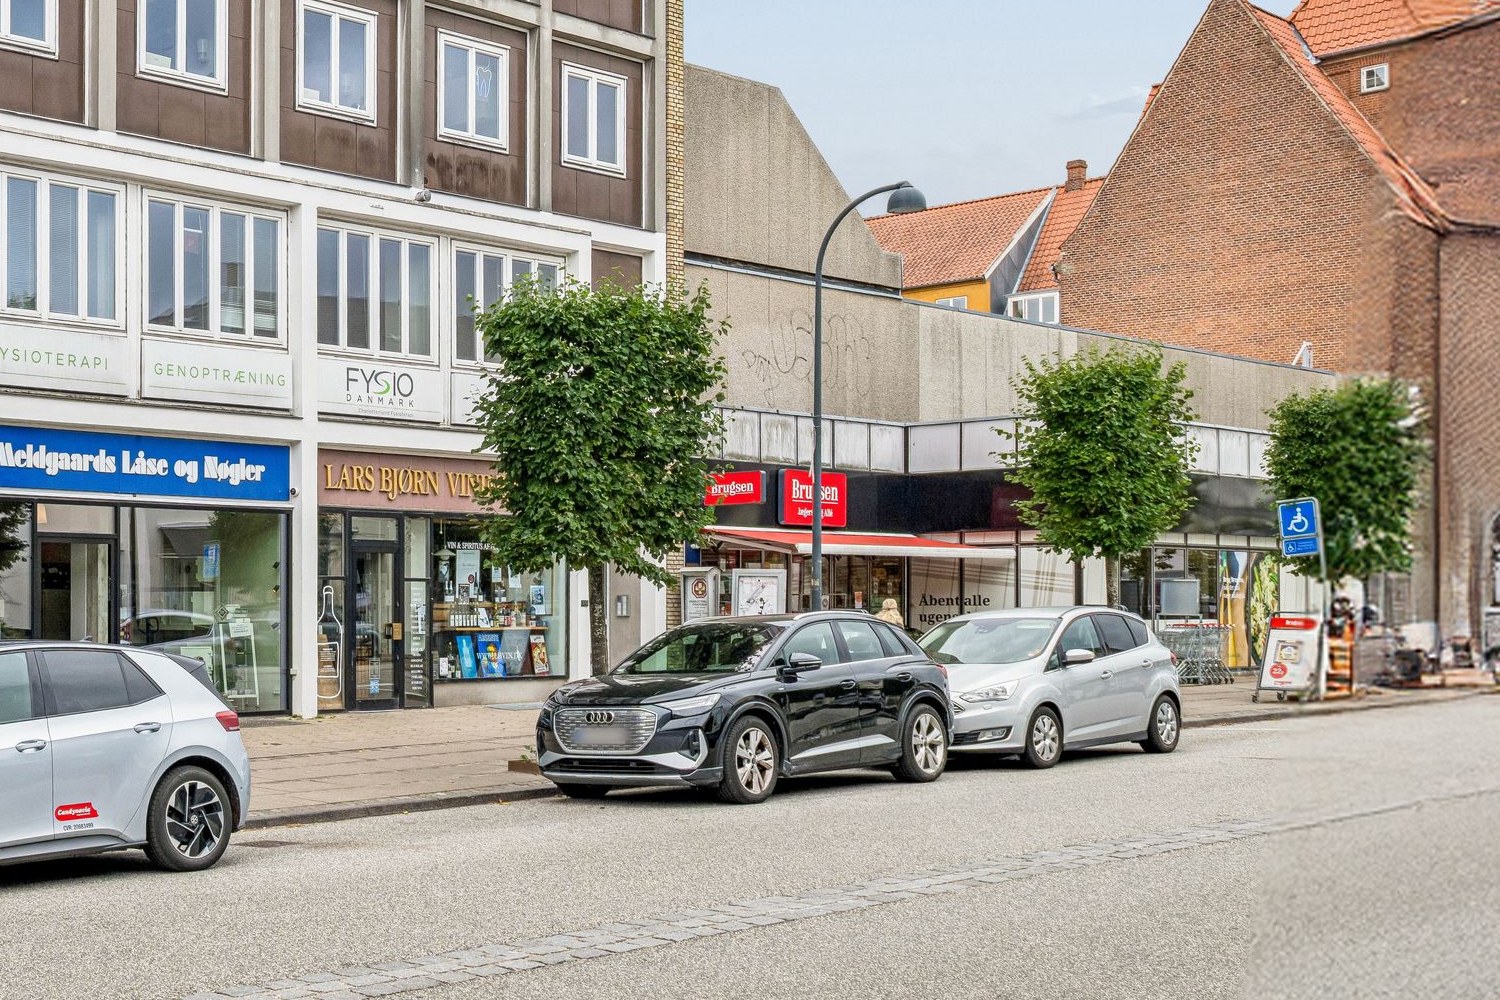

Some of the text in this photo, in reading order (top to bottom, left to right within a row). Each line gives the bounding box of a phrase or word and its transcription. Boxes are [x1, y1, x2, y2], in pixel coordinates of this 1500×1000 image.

[154, 363, 286, 387] GENOPTRÆNING
[346, 367, 414, 397] FYSIO
[346, 394, 414, 407] DANMARK
[121, 450, 169, 476] Låse
[174, 459, 199, 484] og
[204, 455, 266, 486] Nøgler
[324, 464, 376, 491] LARS
[379, 467, 439, 500] BJØRN
[711, 481, 754, 496] Brugsen
[792, 478, 839, 501] Brusen
[919, 593, 991, 606] Åbent alle
